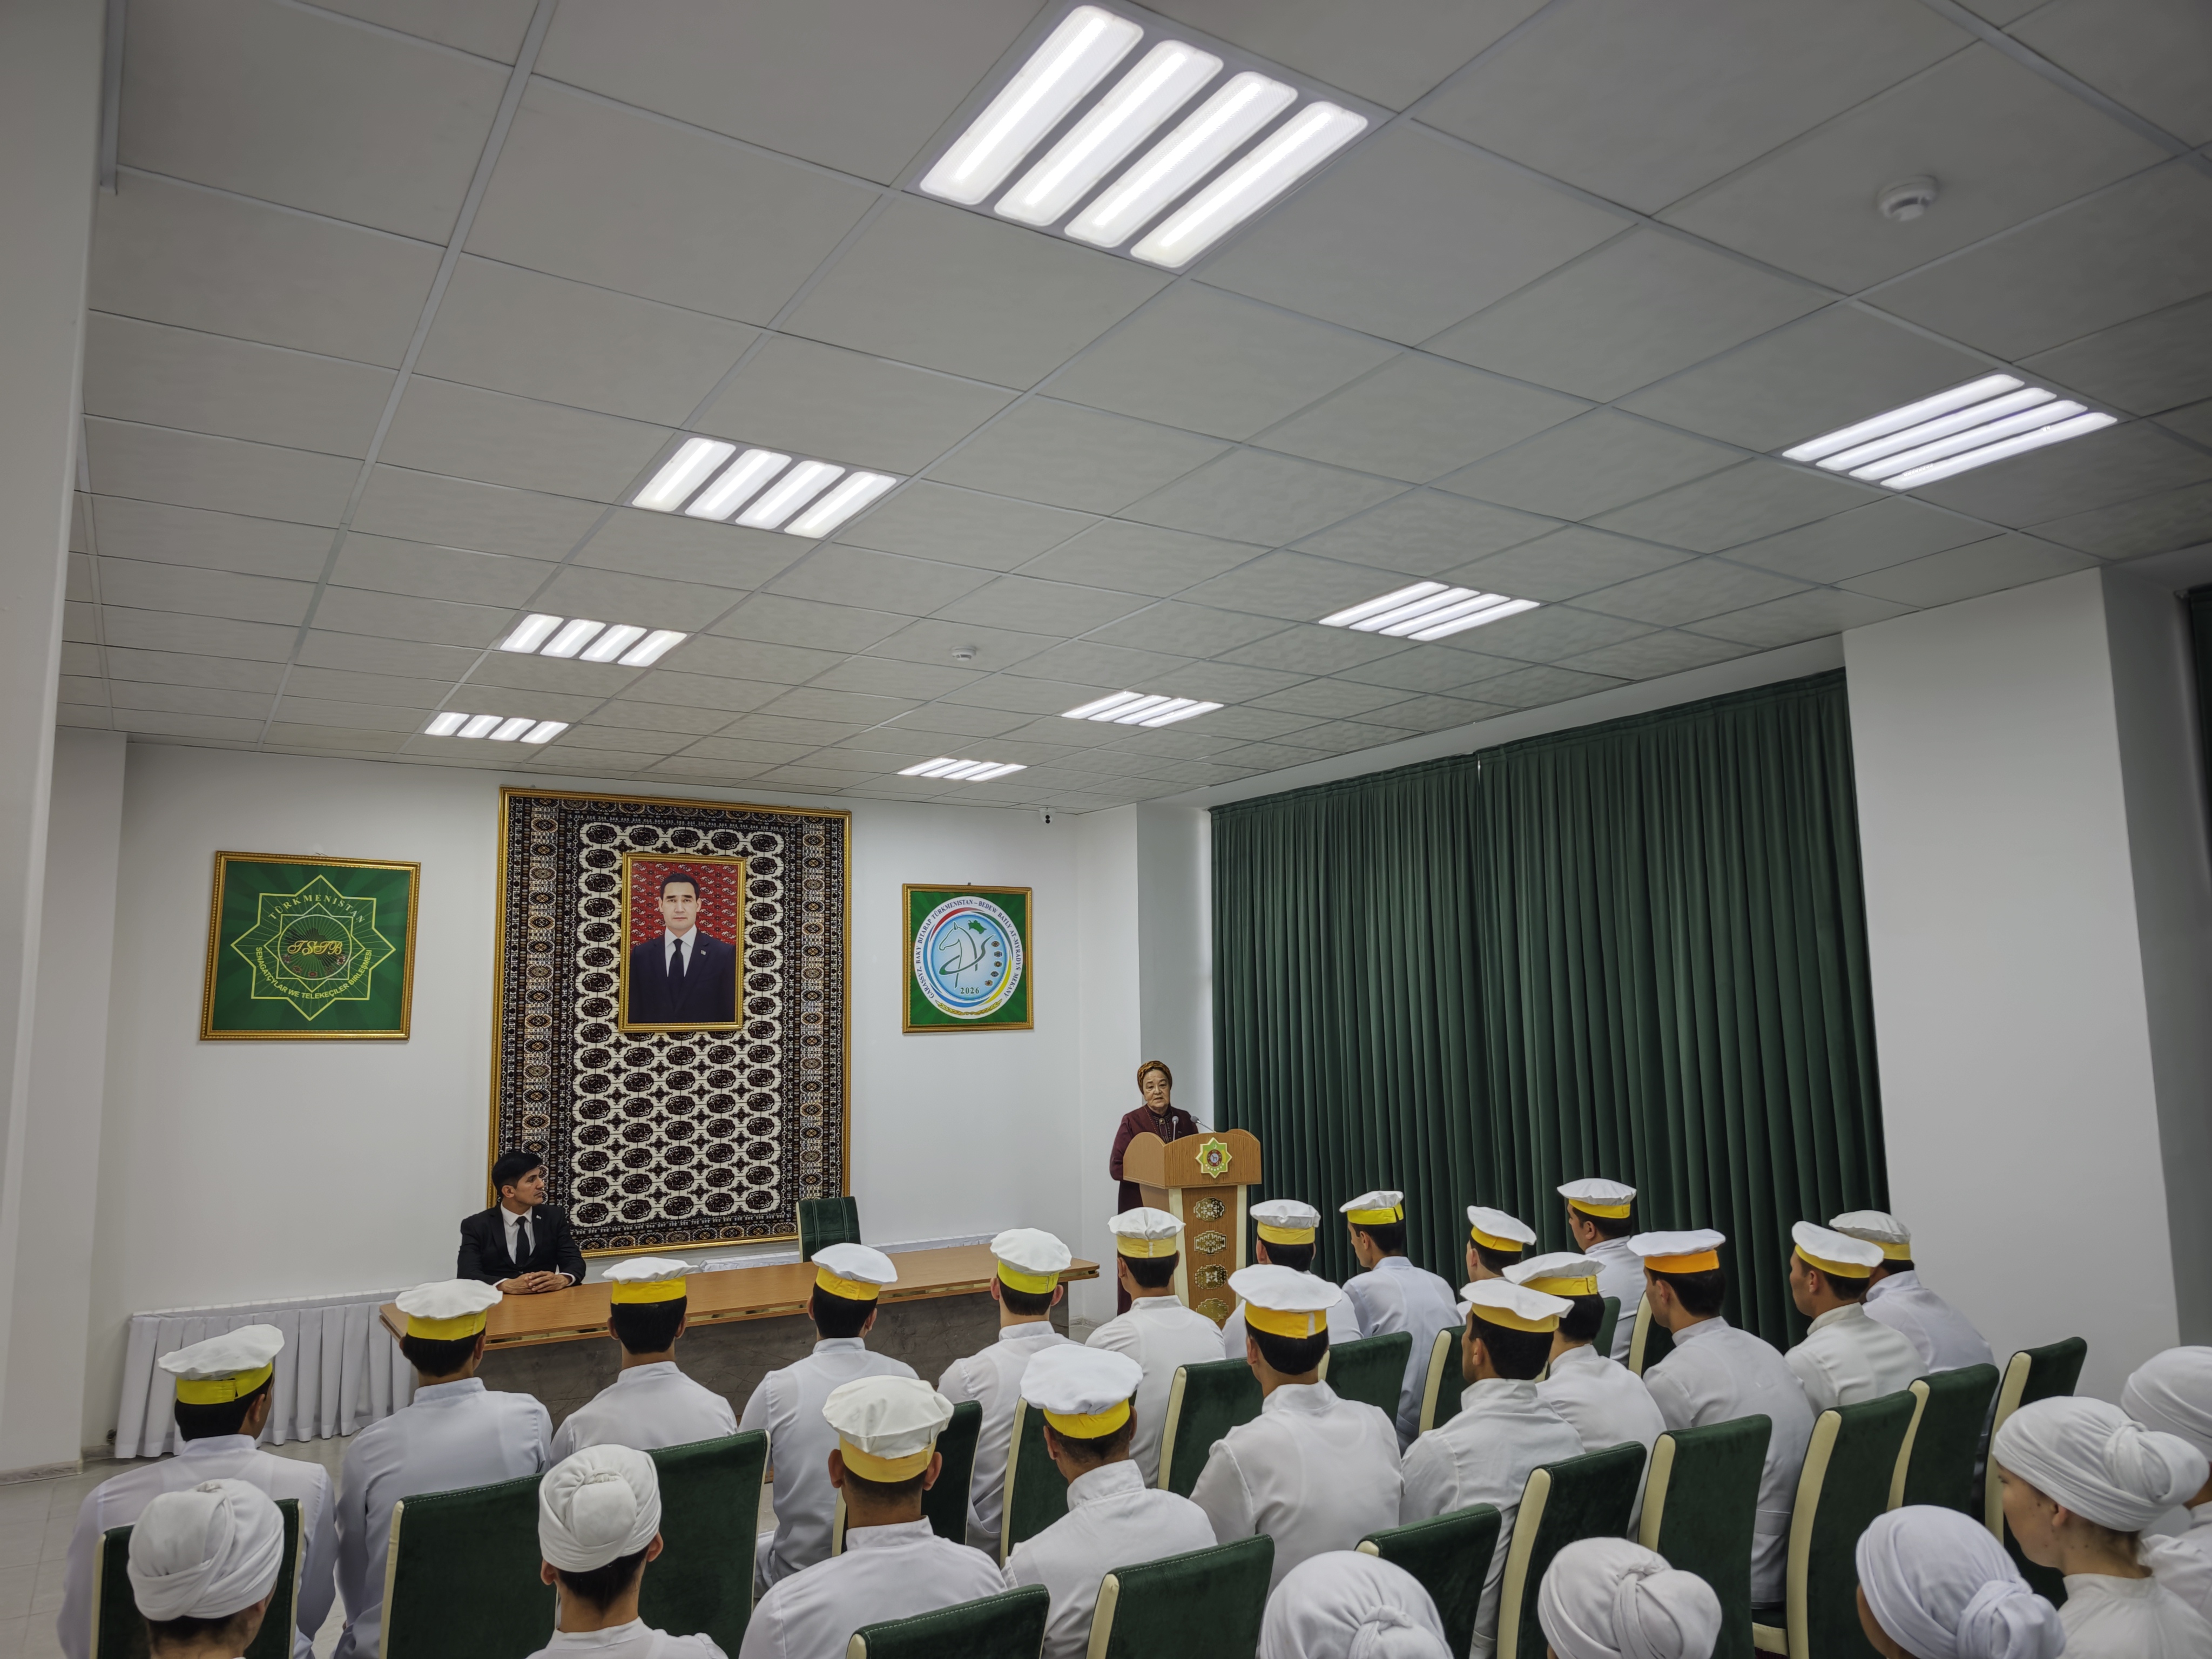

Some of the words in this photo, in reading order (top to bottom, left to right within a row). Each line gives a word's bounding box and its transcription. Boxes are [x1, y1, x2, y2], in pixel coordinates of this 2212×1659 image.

[268, 894, 365, 923] TÜRKMENISTAN
[918, 919, 932, 944] BITARAP
[931, 899, 973, 919] TÜRKMENISTAN
[979, 901, 998, 913] BEDEW
[997, 912, 1012, 928] BATLY
[256, 947, 288, 993] SENAGATÇYLAR
[288, 988, 300, 997] WE
[301, 983, 350, 999] TELEKEÇILER
